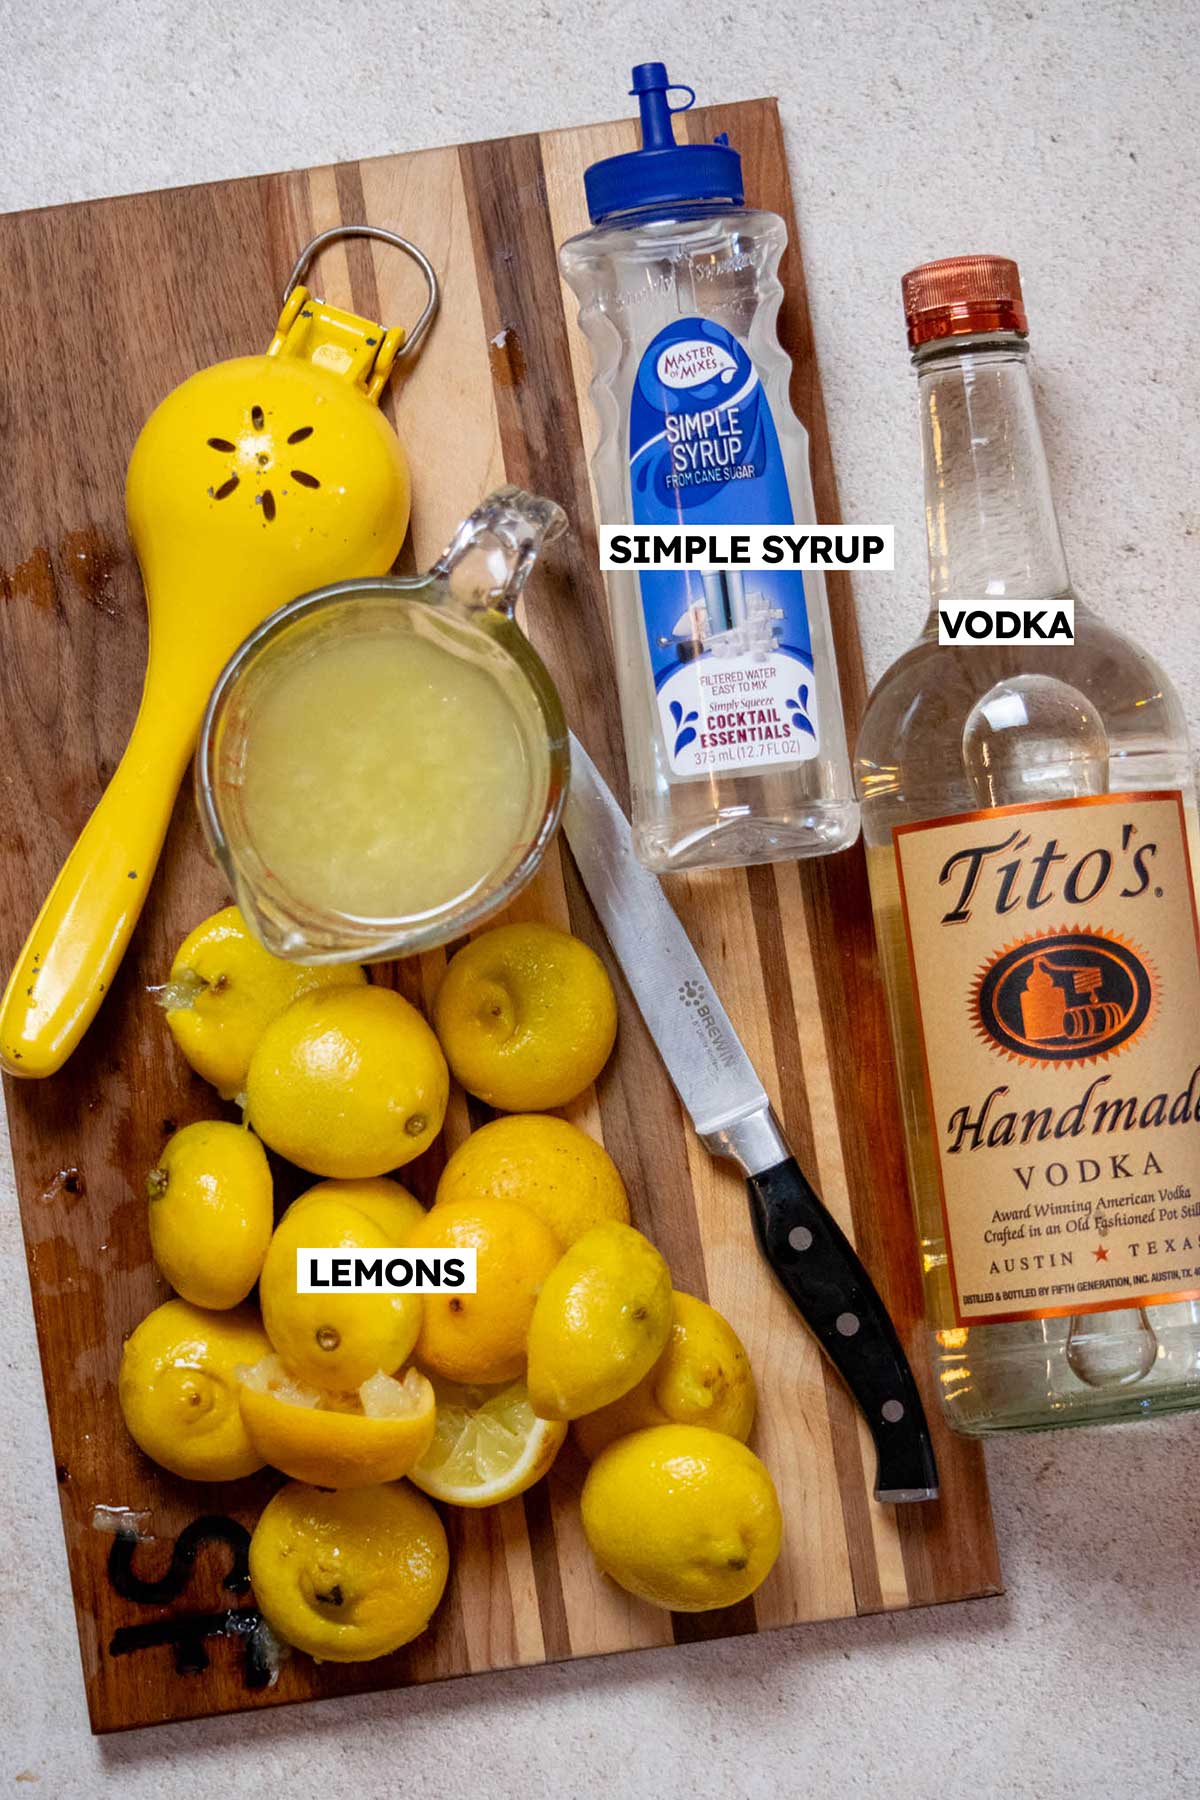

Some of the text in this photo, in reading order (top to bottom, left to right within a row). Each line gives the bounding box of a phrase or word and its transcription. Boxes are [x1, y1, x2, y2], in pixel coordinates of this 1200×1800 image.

[664, 345, 715, 375] MASTER
[679, 358, 718, 381] MIXES
[665, 407, 743, 444] SIMPLE
[672, 438, 742, 472] SYRUP
[666, 464, 756, 489] FROM CANE SUGAR
[700, 667, 777, 687] FILTERED WATER
[711, 680, 768, 696] EASY TO MIX
[706, 708, 782, 731] COCKTAIL
[709, 695, 775, 713] Simply Squeeze
[700, 723, 792, 749] ESSENTIALS
[694, 750, 716, 766] 375
[718, 746, 736, 763] mL
[938, 823, 1157, 925] Tito's
[697, 1004, 736, 1068] BREWIN
[1013, 1150, 1164, 1191] VODKA
[992, 1184, 1192, 1223] Award Winning American Vodka
[983, 1224, 1026, 1247] Crafted
[1029, 1222, 1042, 1238] in
[1045, 1224, 1063, 1236] an
[1066, 1217, 1091, 1233] Old
[1094, 1208, 1156, 1232] Fashioned
[1158, 1207, 1179, 1222] Pot
[989, 1236, 1200, 1275] AUSTIN TEXA
[962, 1293, 996, 1306] DISTILLED
[995, 1292, 1002, 1302] &
[1002, 1287, 1037, 1301] BOTTLED
[1038, 1286, 1051, 1297] BY
[1051, 1283, 1076, 1296] FIFTH
[1076, 1275, 1132, 1293] GENERATION,
[1151, 1268, 1181, 1284] AUSTIN,
